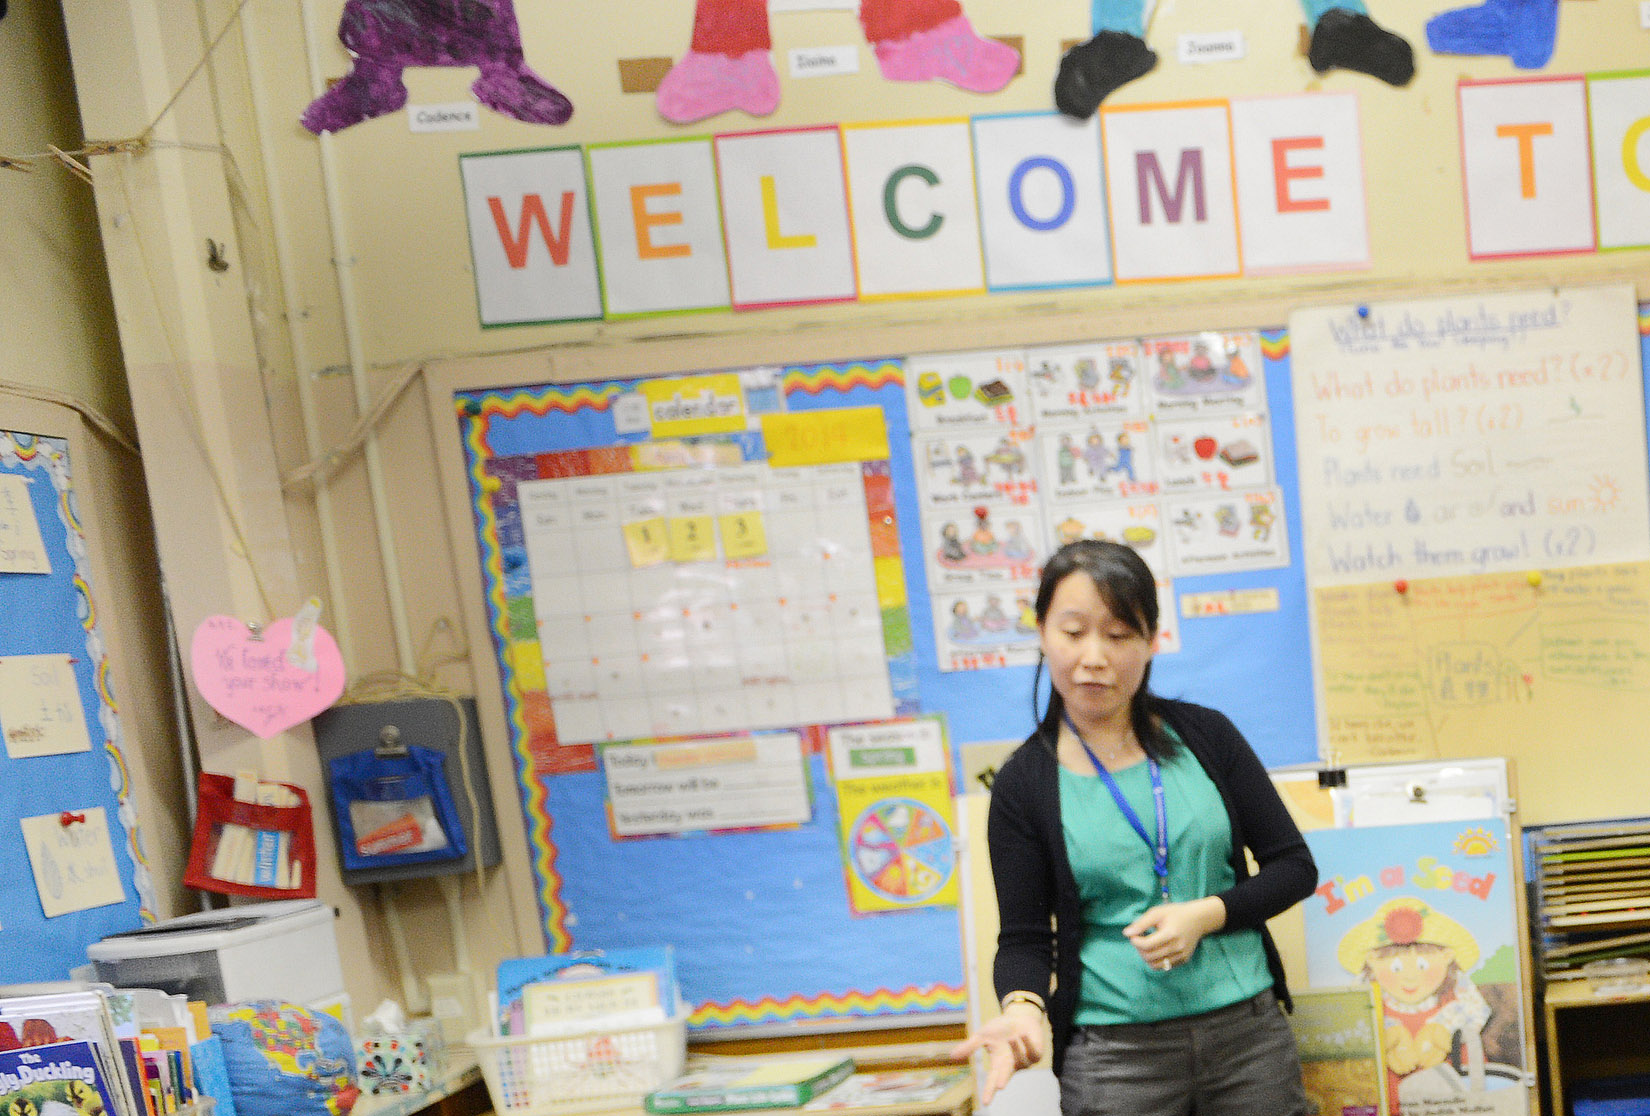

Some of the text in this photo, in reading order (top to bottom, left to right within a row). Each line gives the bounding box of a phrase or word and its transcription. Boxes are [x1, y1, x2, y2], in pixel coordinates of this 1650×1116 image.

[488, 136, 1331, 270] WELCOME
[1379, 865, 1406, 889] a
[1411, 855, 1497, 901] Seed
[17, 1060, 95, 1085] Duckling
[18, 1053, 42, 1064] The
